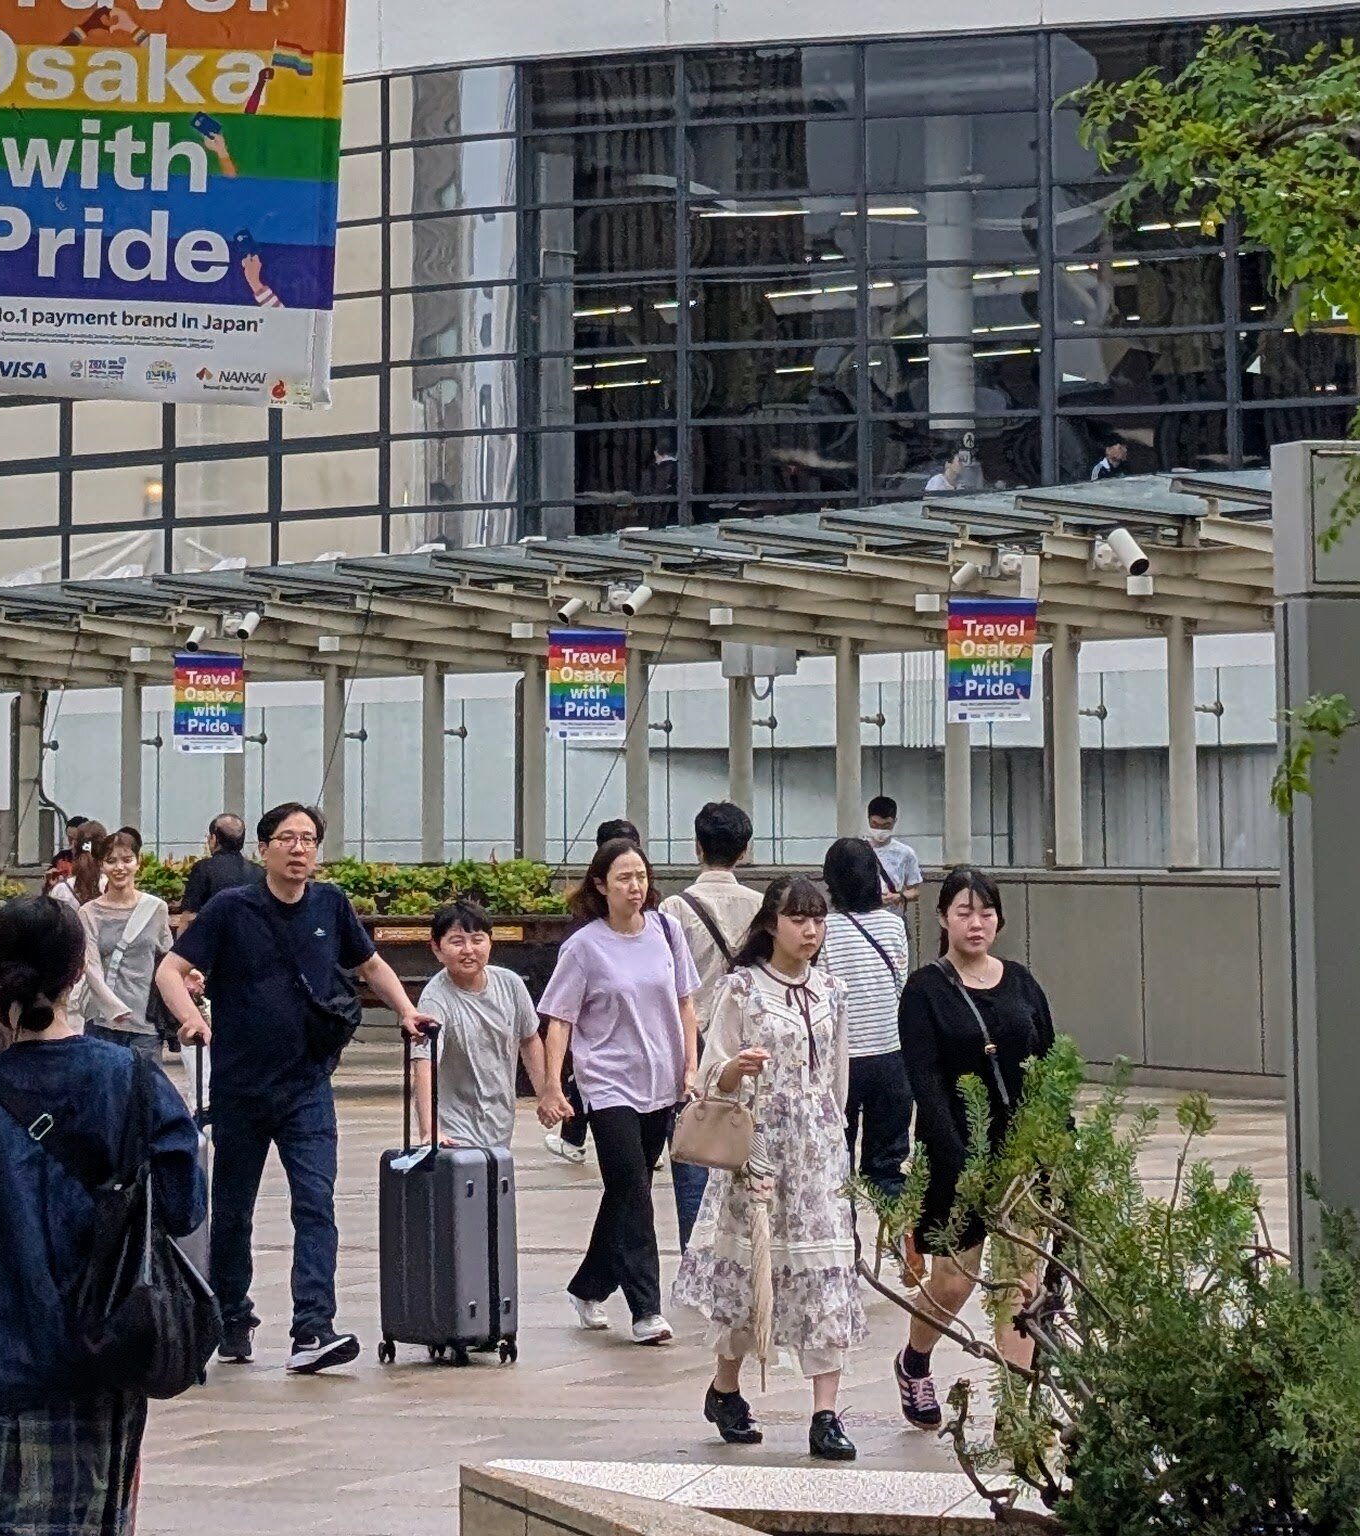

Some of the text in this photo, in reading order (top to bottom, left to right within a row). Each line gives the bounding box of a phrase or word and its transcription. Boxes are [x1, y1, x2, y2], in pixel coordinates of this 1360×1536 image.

[2, 118, 208, 193] with
[32, 310, 118, 328] payment
[122, 311, 177, 329] brand
[182, 314, 198, 330] in
[219, 370, 268, 384] NANKAI
[963, 619, 1025, 637] Travel
[561, 648, 617, 664] Travel
[960, 639, 1022, 657] Osaka
[560, 666, 615, 682] Osaka
[971, 659, 1011, 677] with
[185, 670, 236, 685] Travel
[184, 687, 235, 701] Osaka
[570, 684, 607, 699] with
[965, 679, 1015, 697] Pride
[192, 703, 227, 717] with
[564, 702, 611, 717] Pride
[187, 718, 230, 733] Pride
